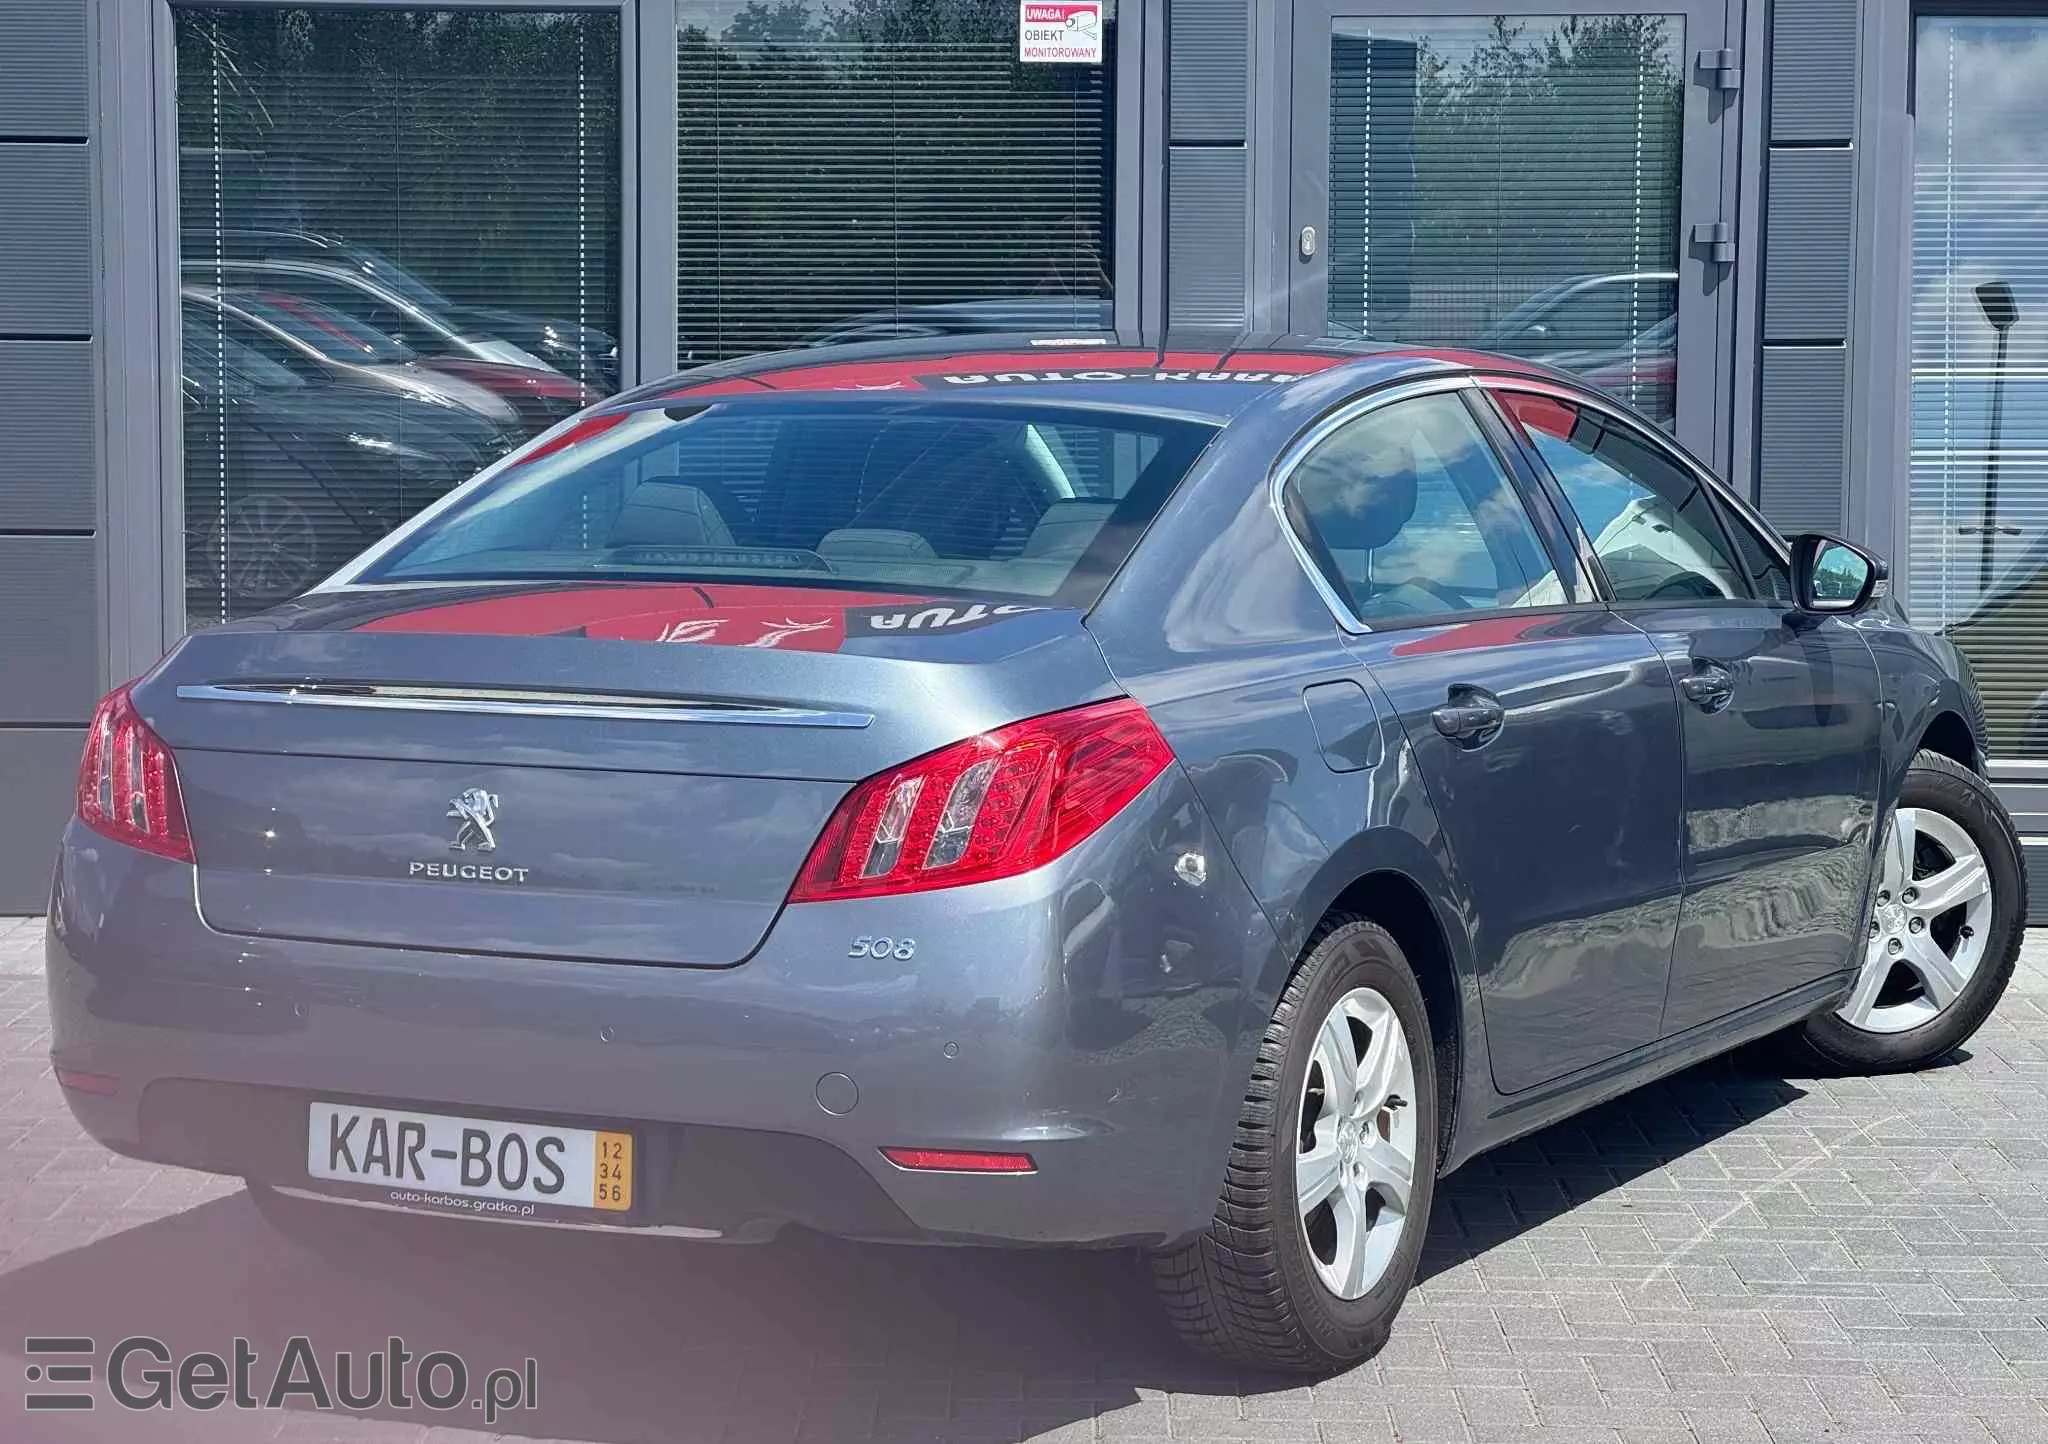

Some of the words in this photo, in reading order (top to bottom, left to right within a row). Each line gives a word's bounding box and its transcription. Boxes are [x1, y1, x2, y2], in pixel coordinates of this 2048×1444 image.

[1025, 30, 1064, 41] OBIEKT
[1024, 47, 1097, 58] MONITOROWANY
[409, 861, 529, 882] PEUGEOT
[848, 935, 916, 960] 508
[328, 1112, 566, 1195] KAR-BOS
[602, 1141, 623, 1160] 12
[600, 1162, 622, 1181] 34
[599, 1183, 622, 1202] 56
